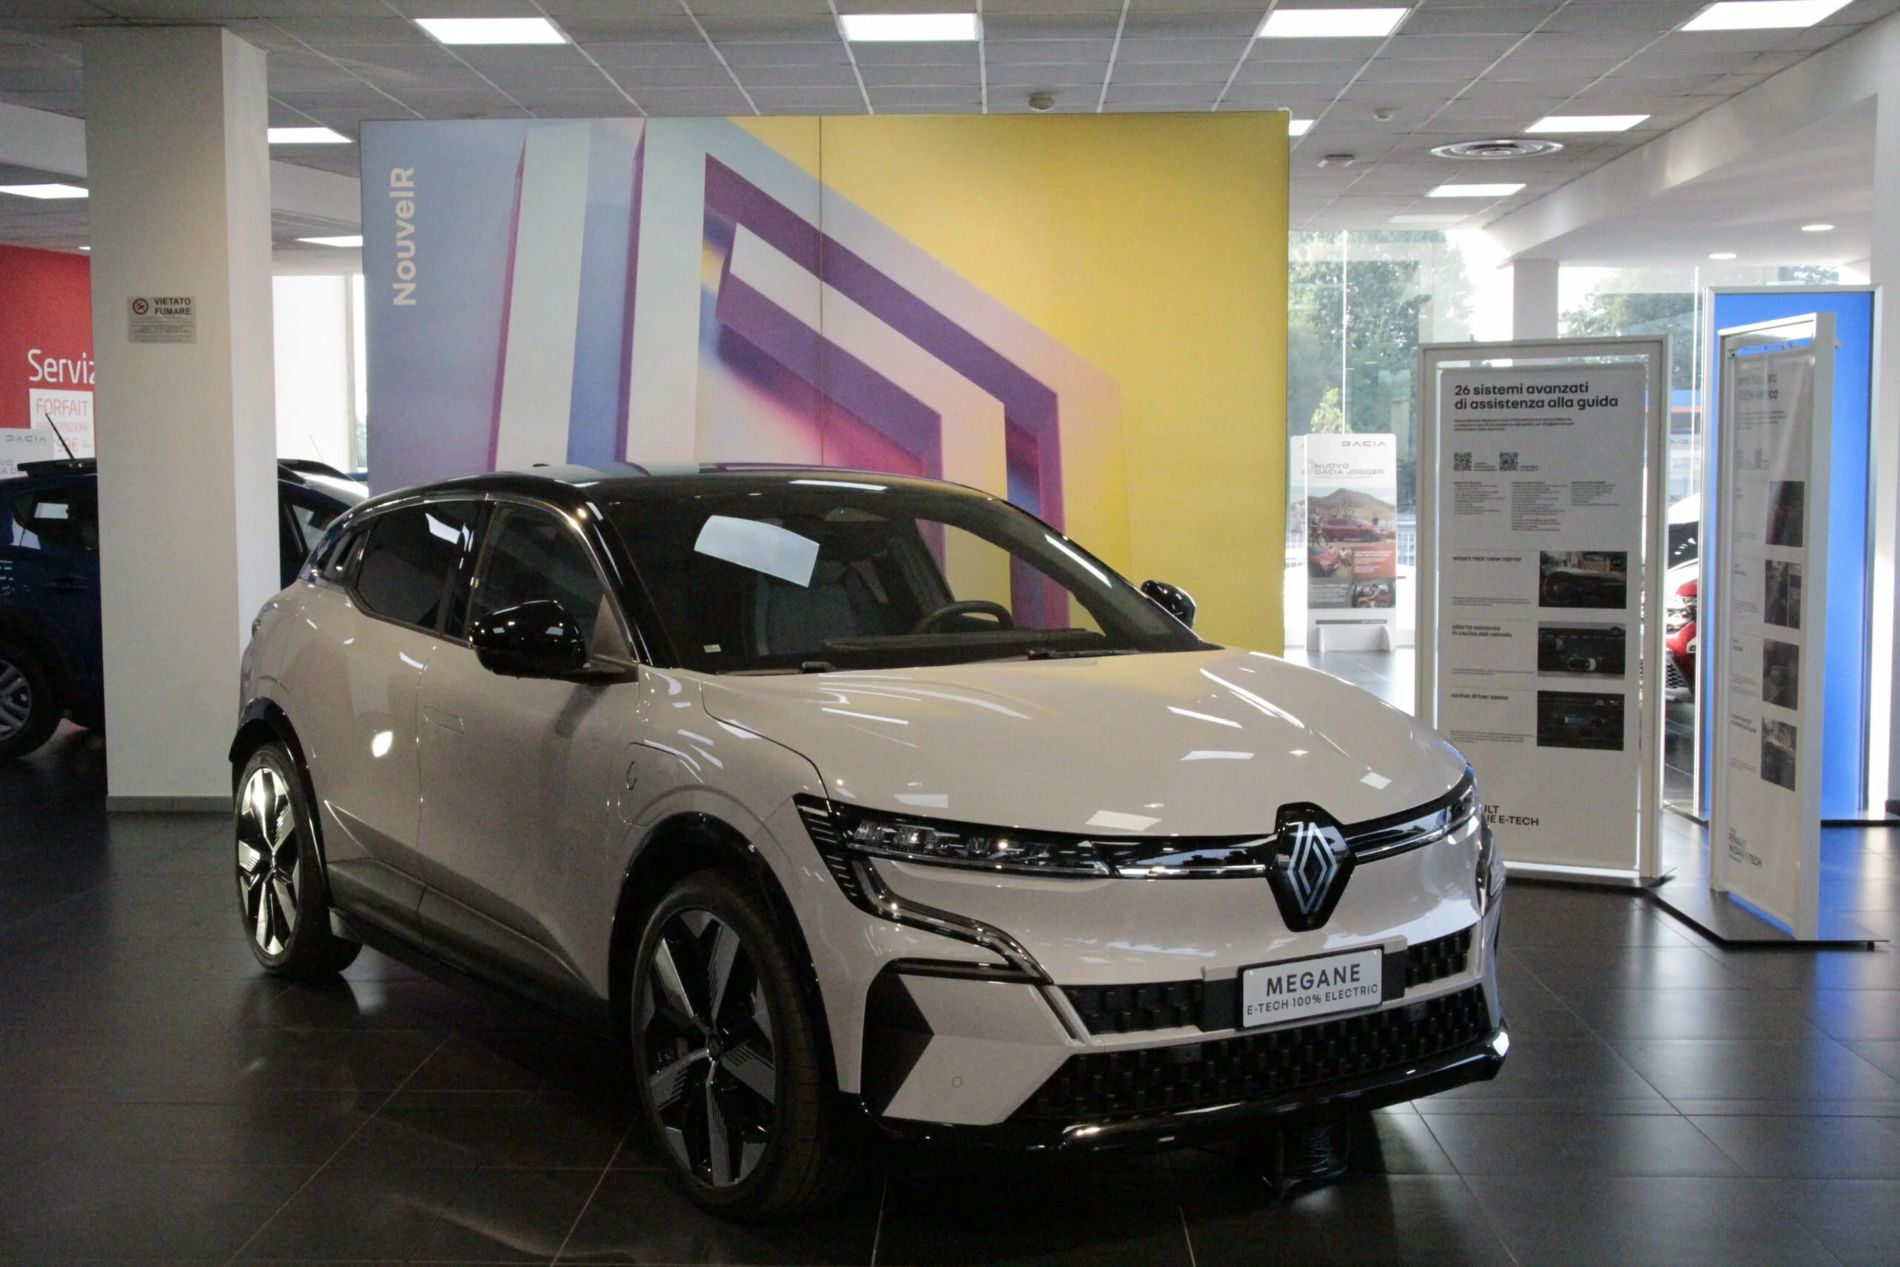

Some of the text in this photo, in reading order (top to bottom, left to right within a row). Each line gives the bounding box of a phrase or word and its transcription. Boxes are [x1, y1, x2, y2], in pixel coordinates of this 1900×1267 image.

[154, 297, 192, 306] VIETATO
[154, 307, 193, 316] FUMARE
[1454, 381, 1589, 397] 26 sistemi avanzati
[36, 398, 89, 417] FORFAIT
[1454, 395, 1619, 411] di assistenza alla guida
[1341, 440, 1386, 448] DACIA
[1314, 468, 1385, 476] DACIA JOGGER
[1498, 815, 1540, 827] E-TECH
[1266, 963, 1361, 997] MEGANE
[1247, 983, 1378, 1016] E-TECH 100% ELECTRIC
